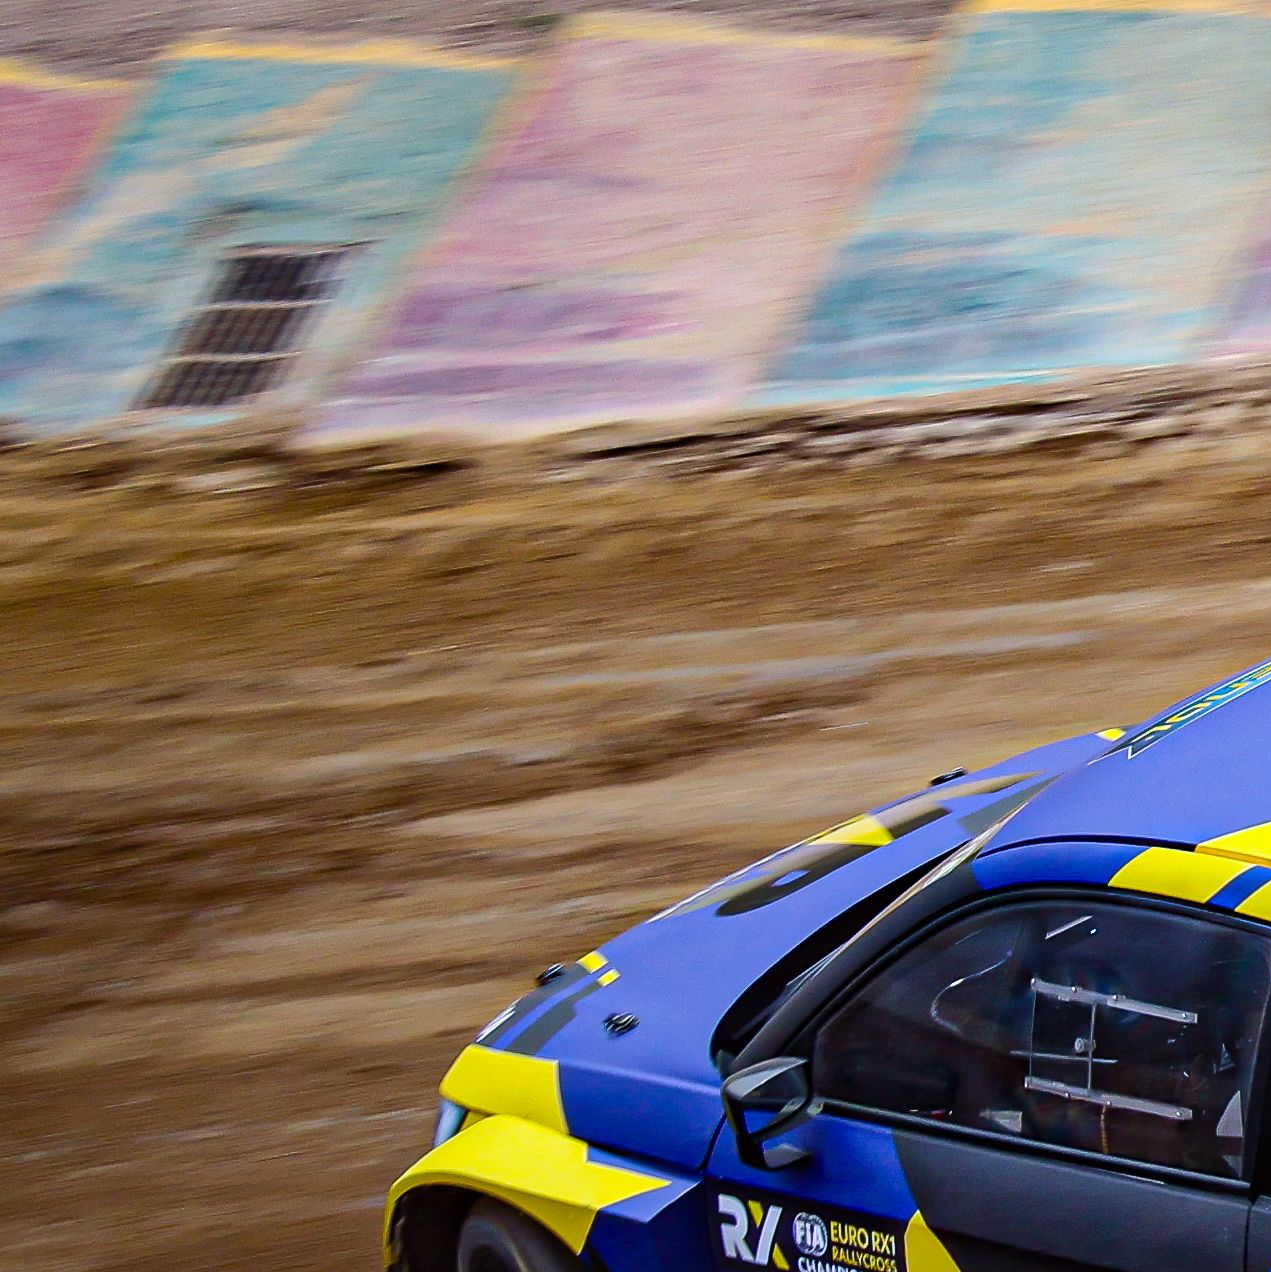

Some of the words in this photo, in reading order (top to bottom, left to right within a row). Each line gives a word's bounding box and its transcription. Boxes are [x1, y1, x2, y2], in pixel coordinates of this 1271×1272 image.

[717, 1193, 790, 1272] RX
[795, 1218, 827, 1252] FIA
[829, 1220, 869, 1249] EURO
[871, 1230, 897, 1256] RX1
